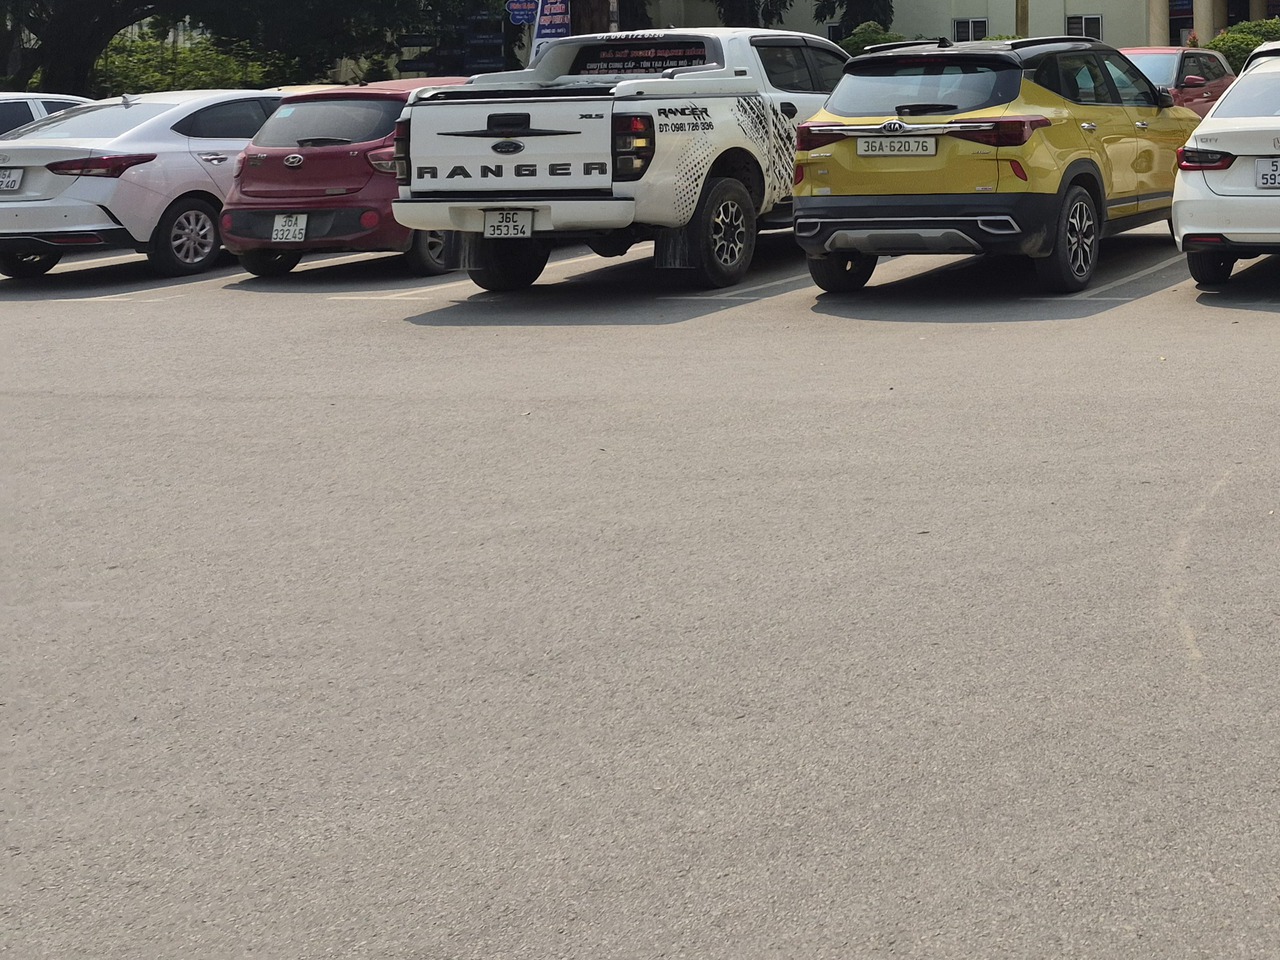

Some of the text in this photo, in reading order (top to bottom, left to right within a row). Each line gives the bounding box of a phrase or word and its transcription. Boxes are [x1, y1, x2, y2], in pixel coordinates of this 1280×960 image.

[657, 106, 711, 122] RANGER
[671, 123, 686, 132] 0981
[687, 122, 700, 132] 726
[701, 121, 714, 131] 336
[885, 122, 902, 132] KIA
[862, 140, 929, 153] 36A-620.76
[416, 161, 608, 180] RANGER
[281, 216, 298, 228] 36A
[498, 212, 519, 224] 36C
[272, 228, 304, 241] 332.45
[489, 225, 526, 237] 353.54
